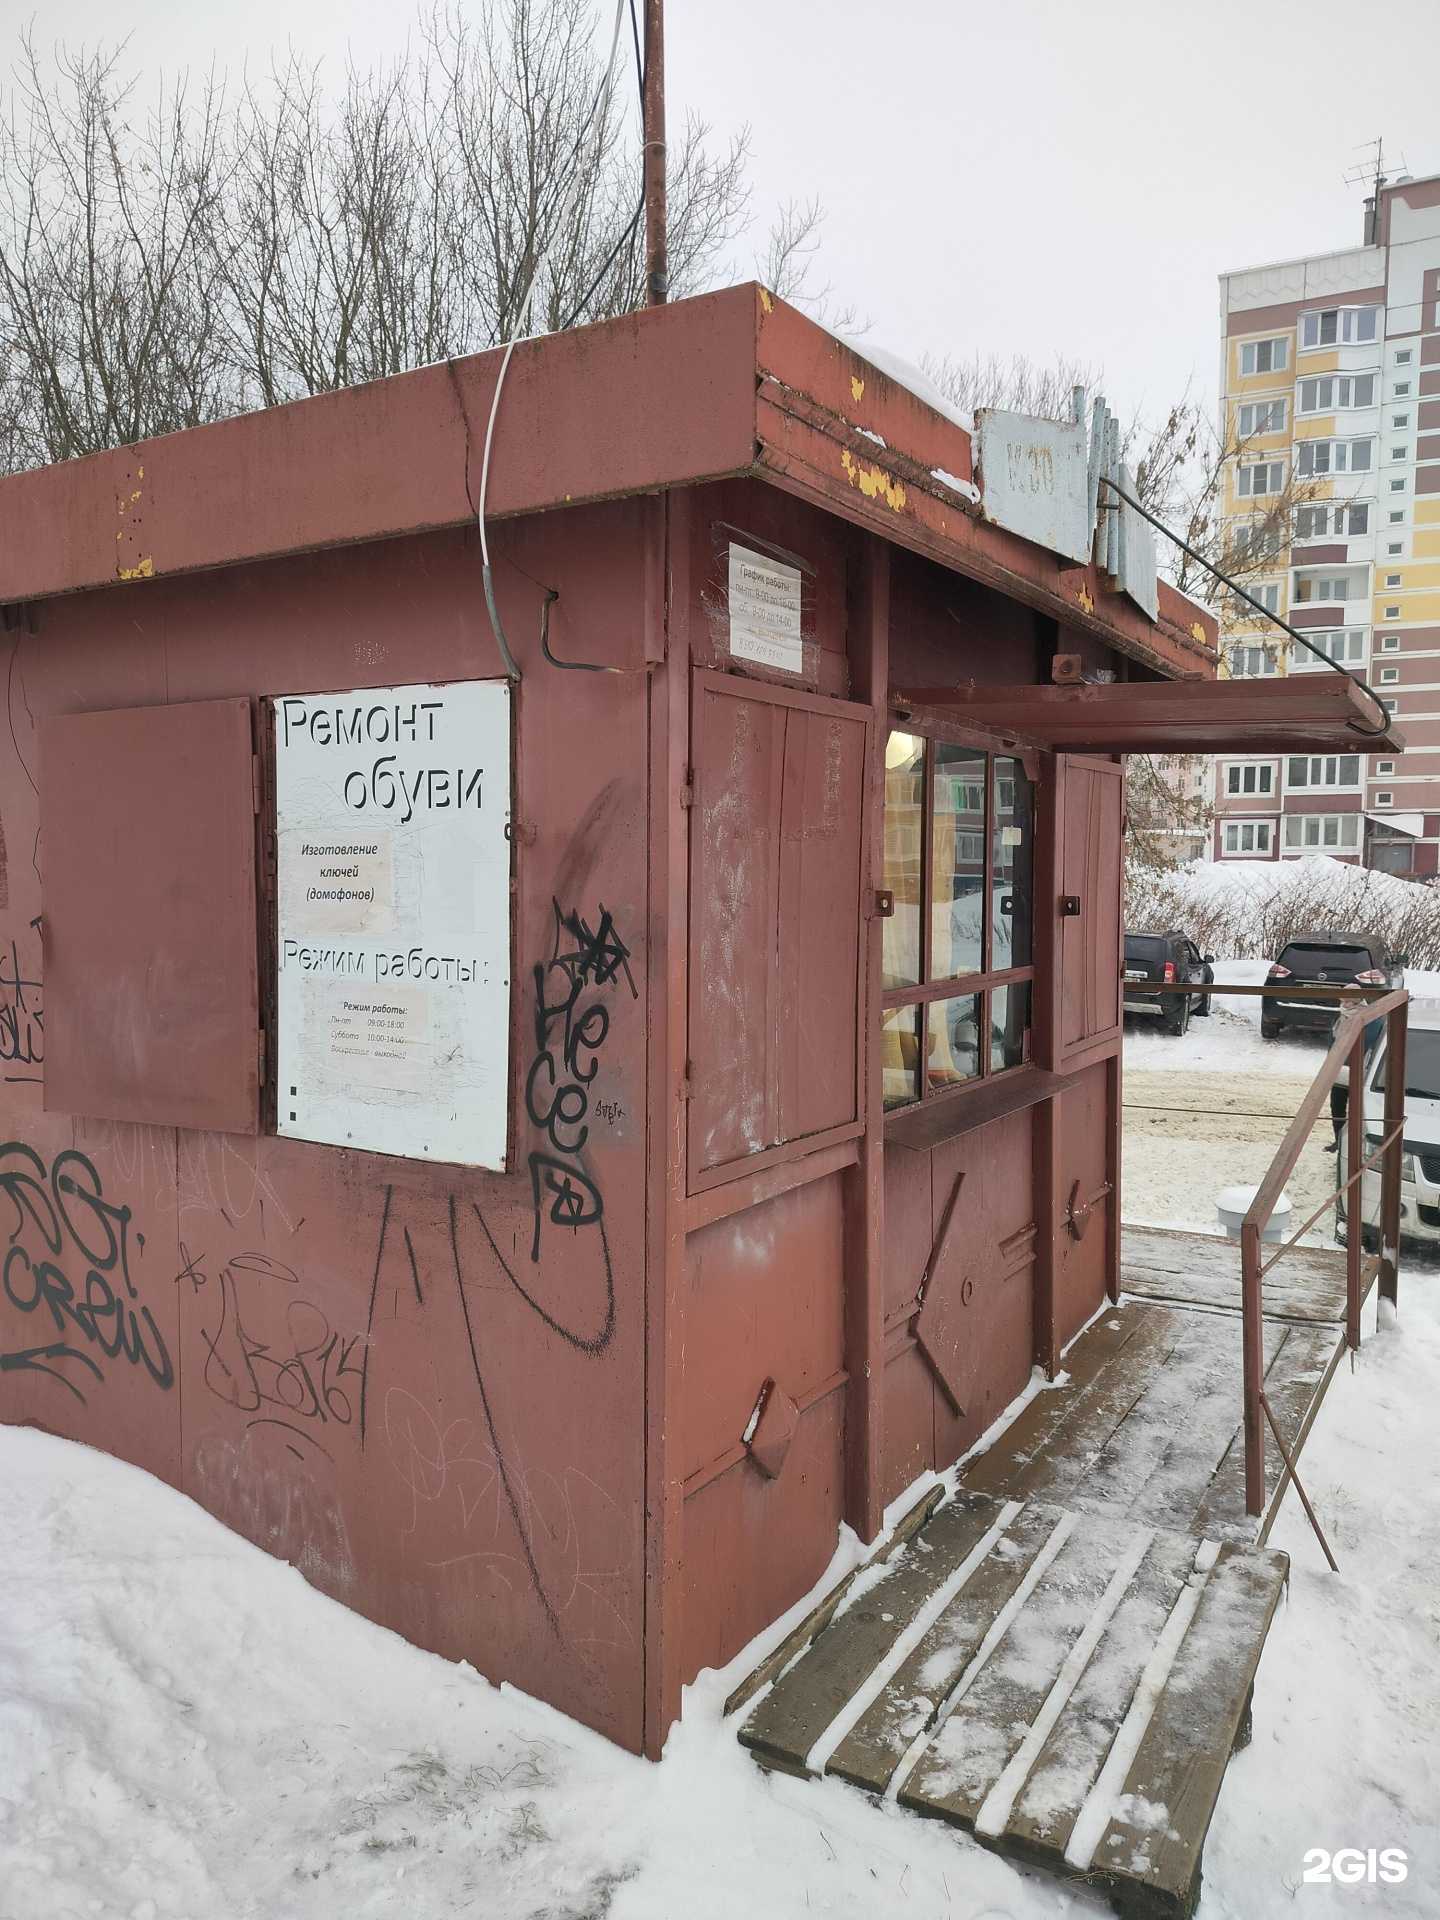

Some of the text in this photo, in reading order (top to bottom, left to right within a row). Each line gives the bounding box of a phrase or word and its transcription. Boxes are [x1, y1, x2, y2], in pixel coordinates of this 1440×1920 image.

[283, 699, 444, 747] Ремонт
[344, 755, 484, 824] обуви
[301, 844, 378, 856] Изготовление
[320, 865, 359, 878] ключей
[306, 887, 375, 902] (домофонов)
[283, 939, 365, 975] Режим
[343, 1001, 408, 1015] Режим работы:
